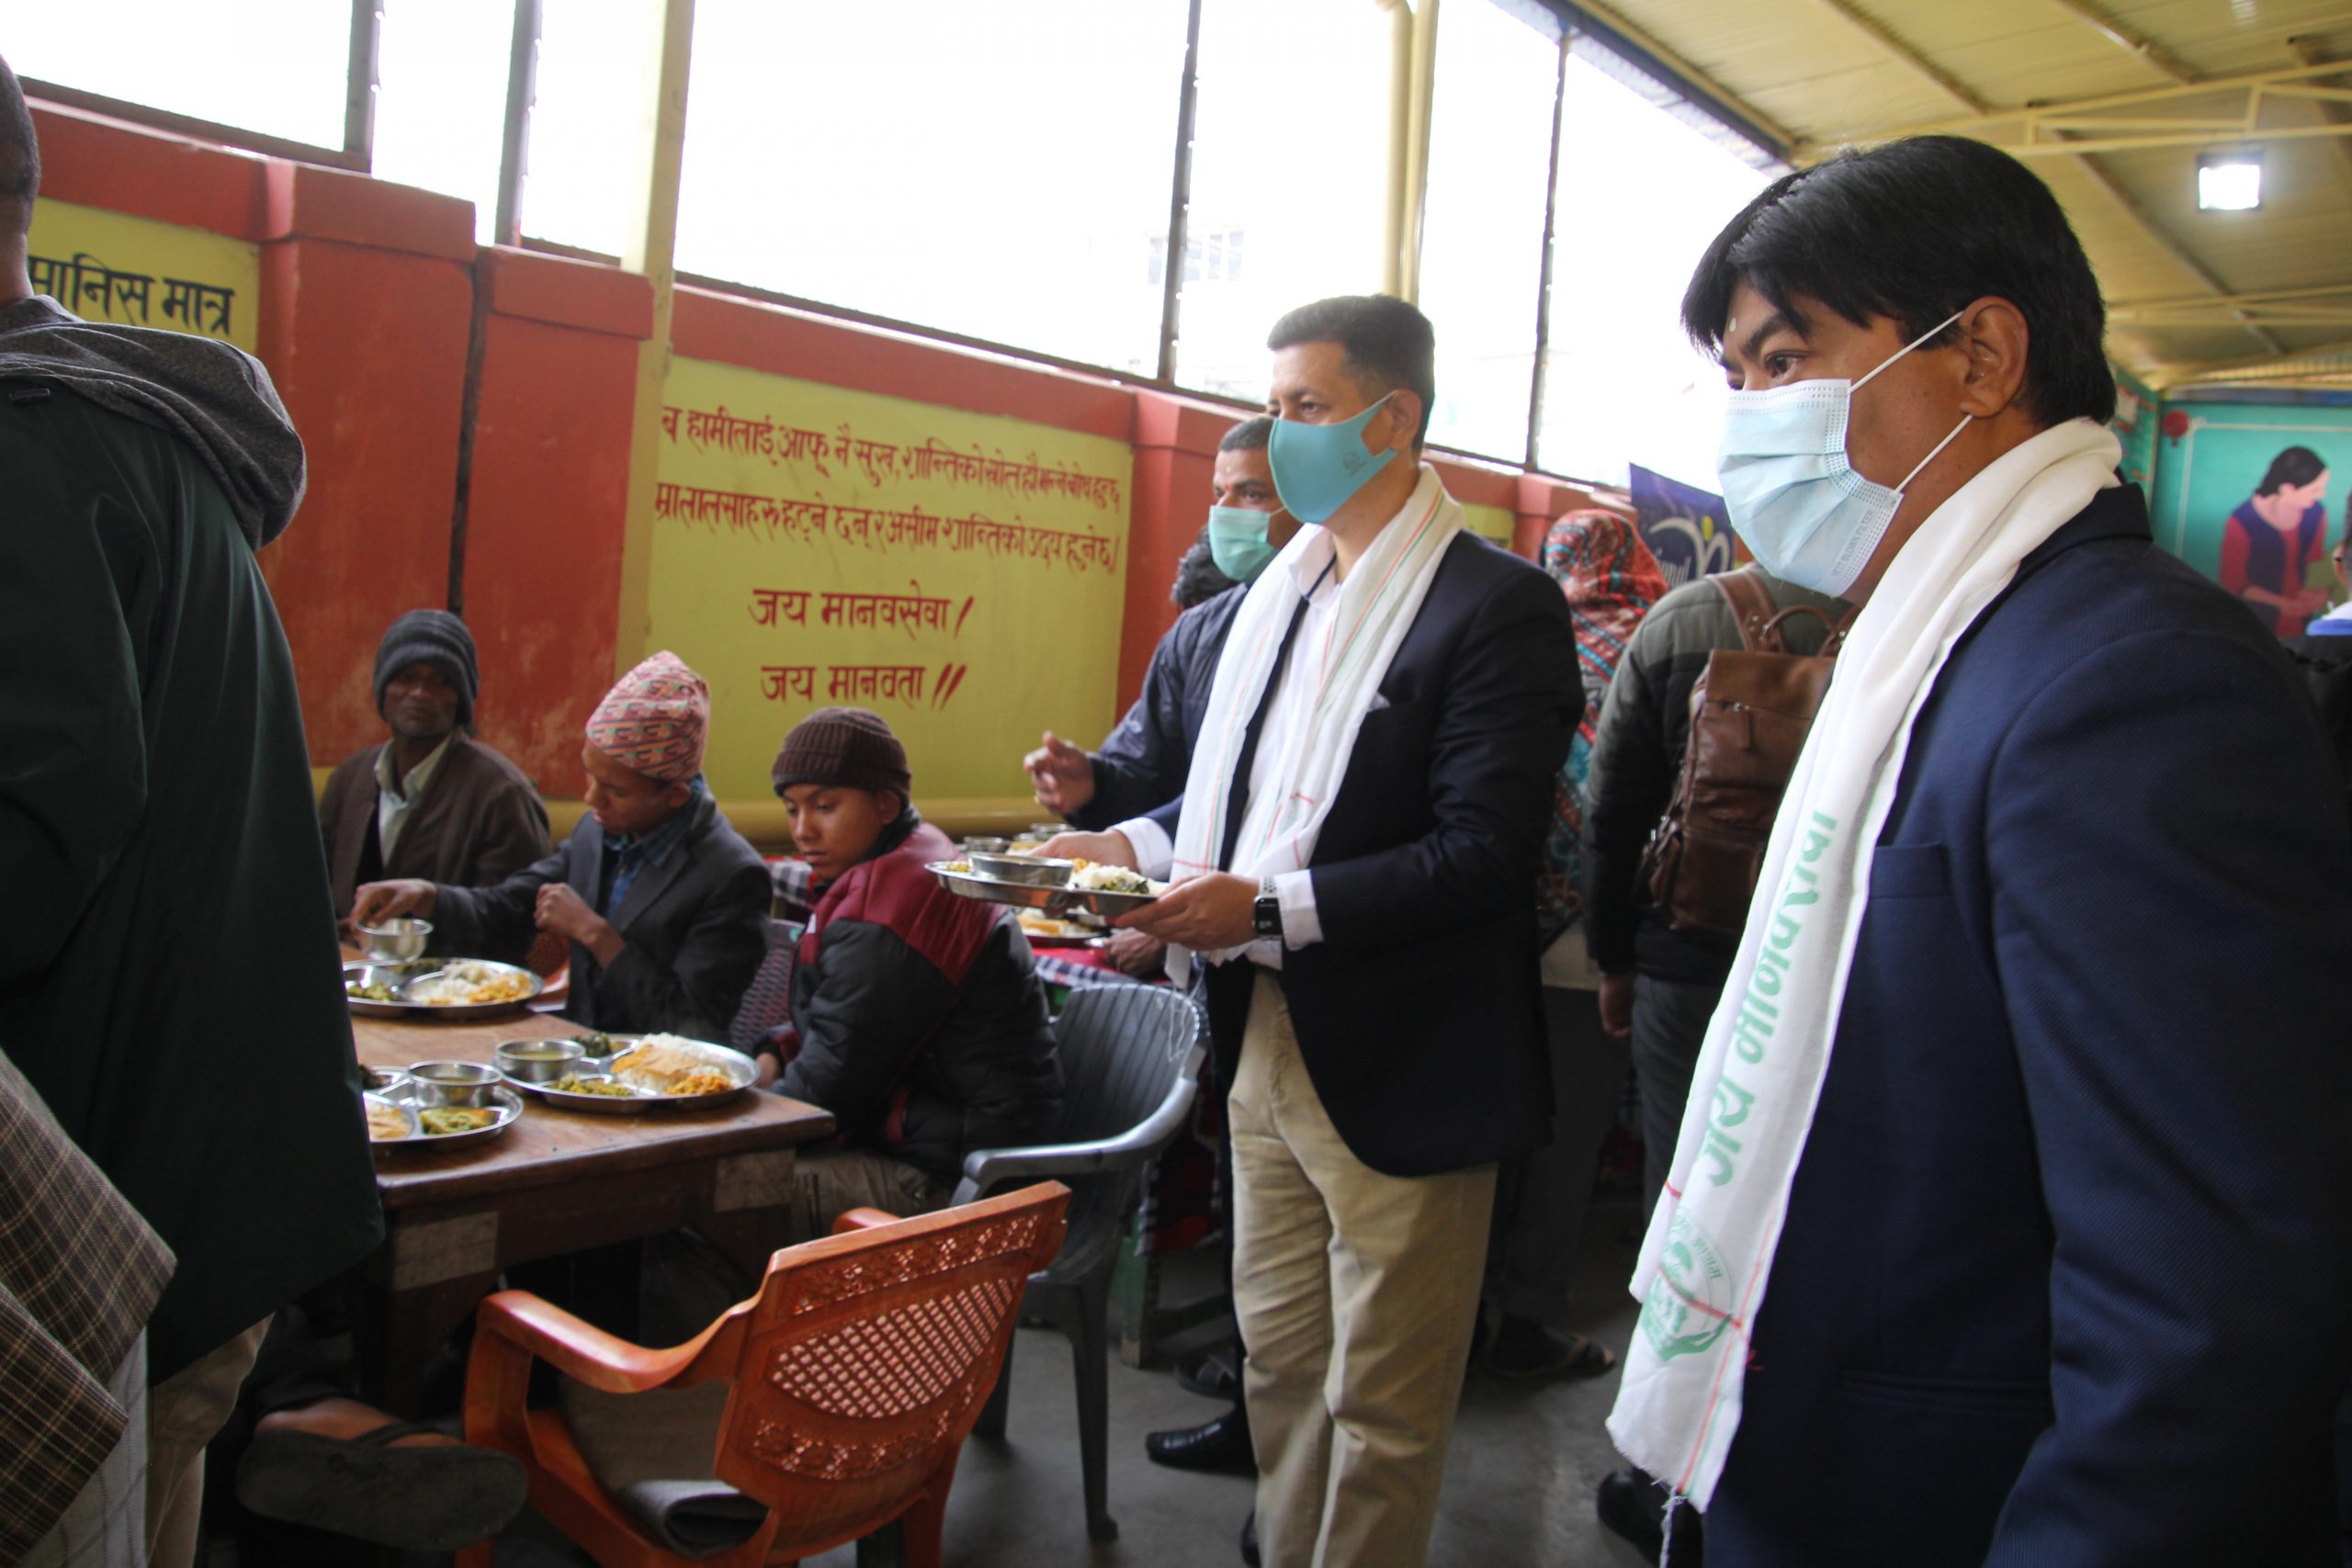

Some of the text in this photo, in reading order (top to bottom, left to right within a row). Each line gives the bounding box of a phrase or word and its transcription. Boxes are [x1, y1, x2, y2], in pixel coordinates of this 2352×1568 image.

[161, 276, 235, 336] मात्र
[747, 588, 812, 628] जय
[760, 666, 817, 703] जय
